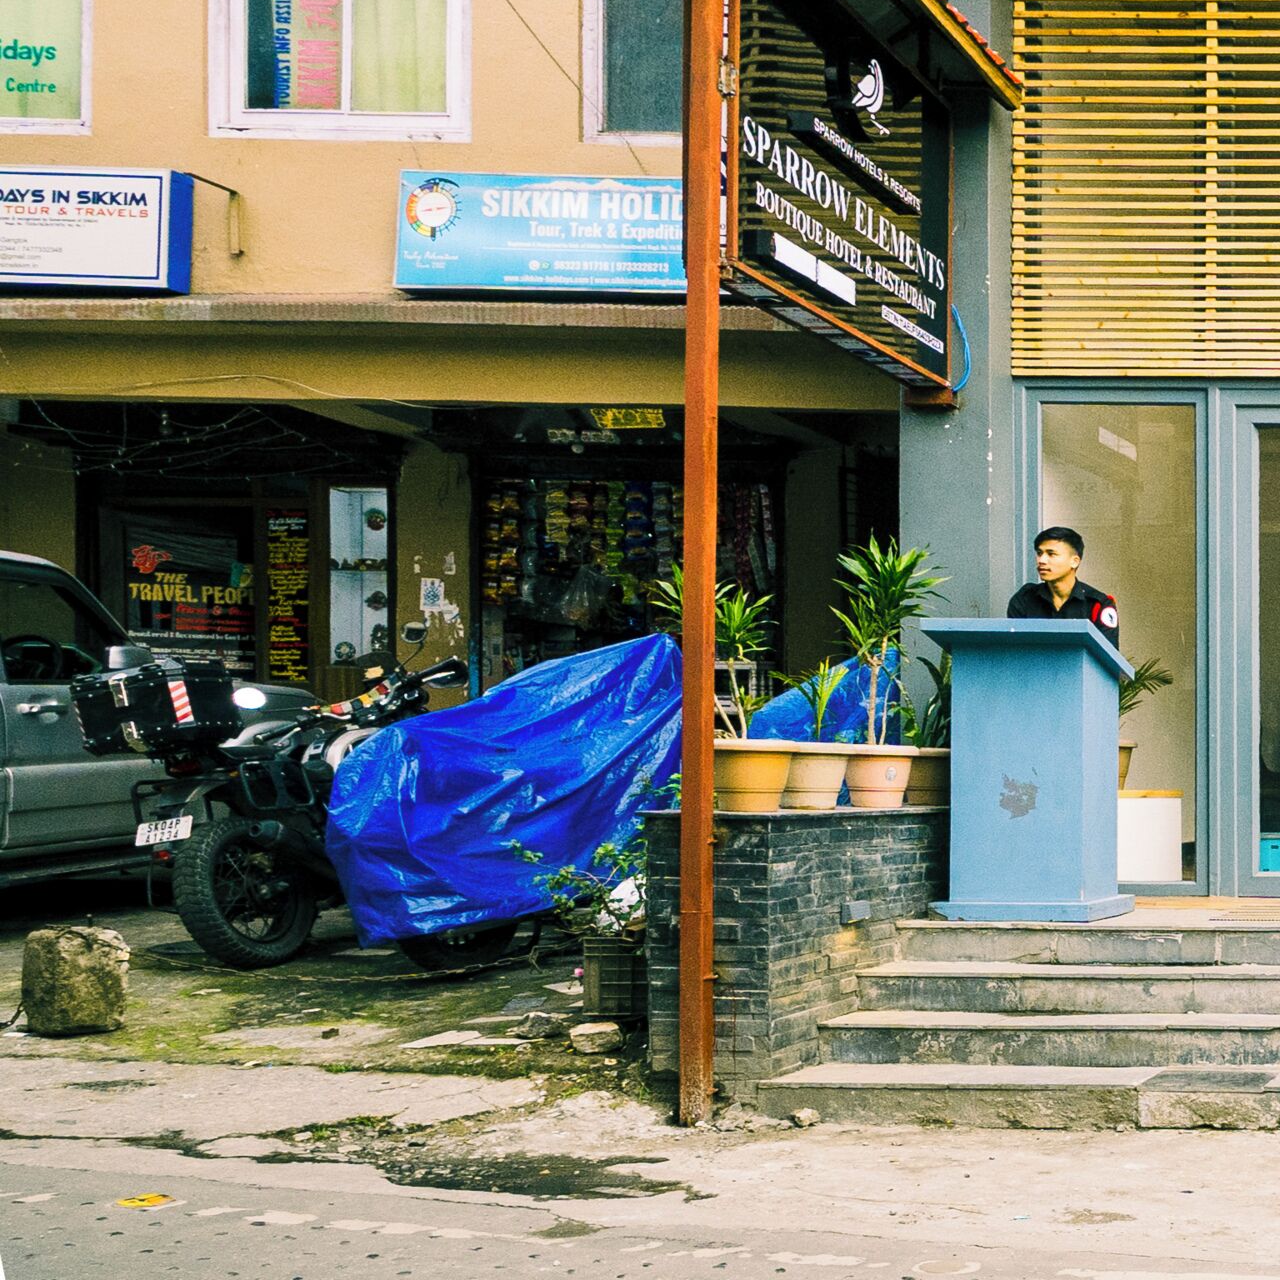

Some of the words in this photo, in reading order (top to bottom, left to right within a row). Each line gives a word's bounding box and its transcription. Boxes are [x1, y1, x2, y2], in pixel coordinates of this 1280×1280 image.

[275, 27, 291, 55] INFO
[5, 76, 57, 94] Centre
[813, 116, 854, 158] SPARROW
[854, 150, 883, 182] HOTELS
[890, 177, 921, 212] RESORTS
[0, 188, 46, 204] AYS
[52, 190, 70, 204] IN
[77, 190, 148, 207] SIKKIM
[481, 189, 589, 219] SIKKIM
[742, 115, 852, 222] SPARROW
[854, 197, 945, 292] ELEMENTS
[4, 205, 50, 215] TOUR
[57, 207, 68, 216] &
[75, 207, 149, 219] TRAVELS
[529, 221, 565, 239] Tour,
[570, 222, 602, 238] Trek
[607, 223, 617, 239] &
[755, 180, 824, 246] BOUTIQUE
[825, 228, 865, 273] HOTEL
[865, 255, 874, 279] &
[874, 261, 938, 320] RESTAURANT
[153, 571, 189, 585] THE
[128, 582, 199, 604] TRAVEL
